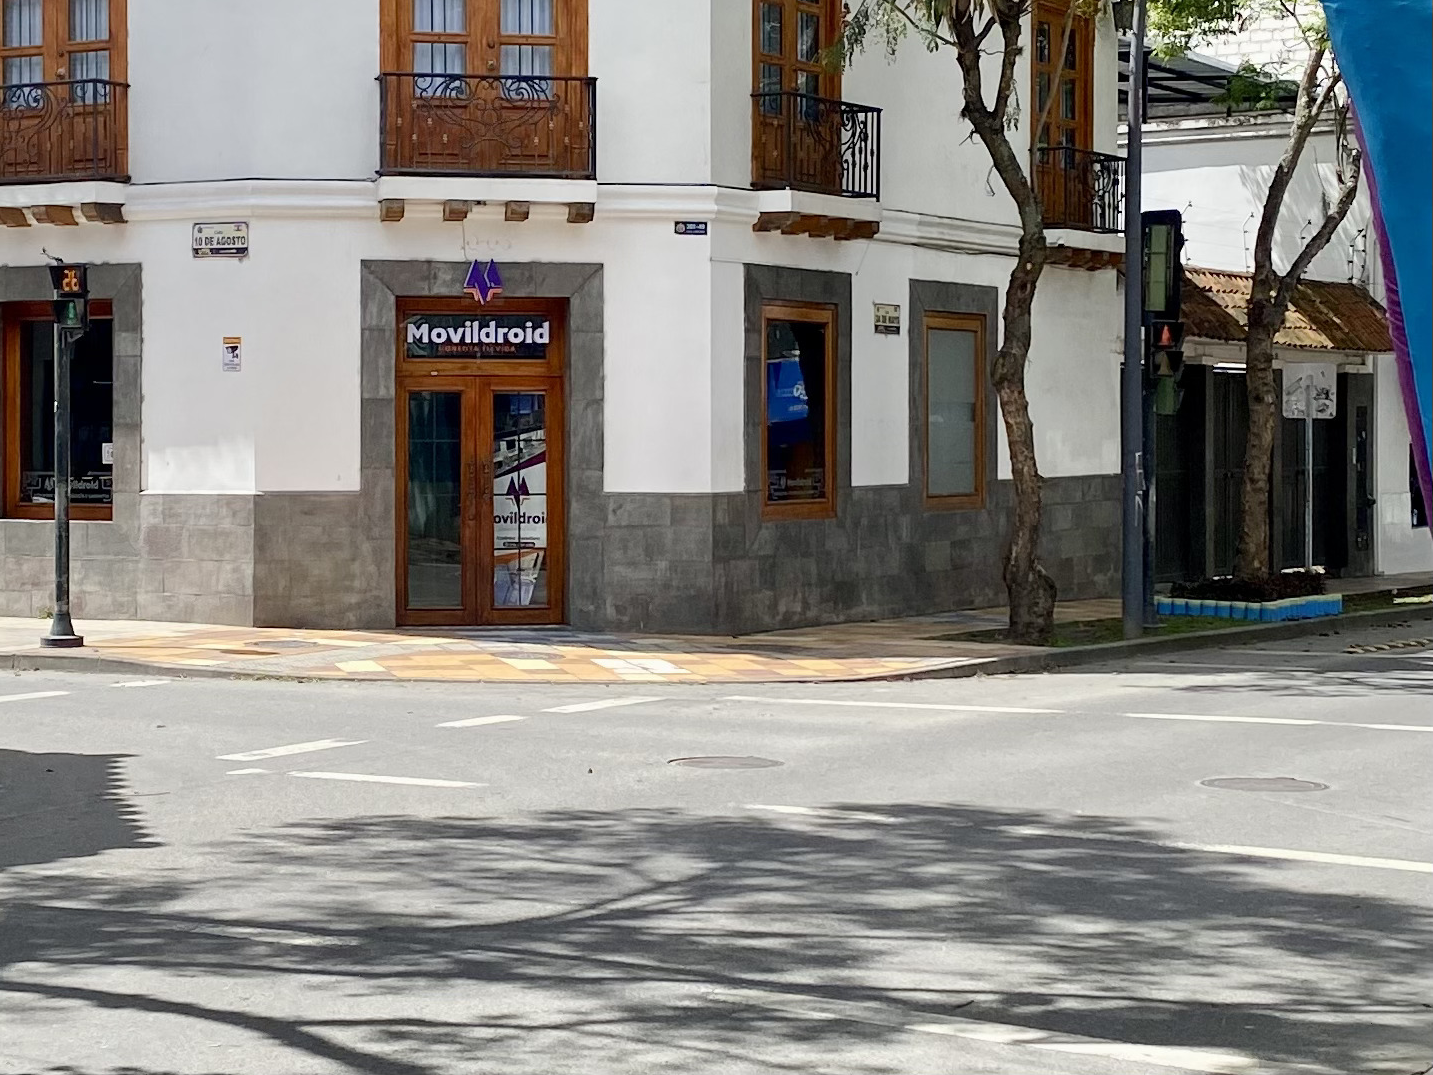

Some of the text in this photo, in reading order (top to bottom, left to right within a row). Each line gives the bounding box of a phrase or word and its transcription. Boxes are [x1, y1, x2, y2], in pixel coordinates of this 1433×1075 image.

[194, 235, 246, 247] 10 DE AGOSTO
[406, 320, 550, 344] Movildroid
